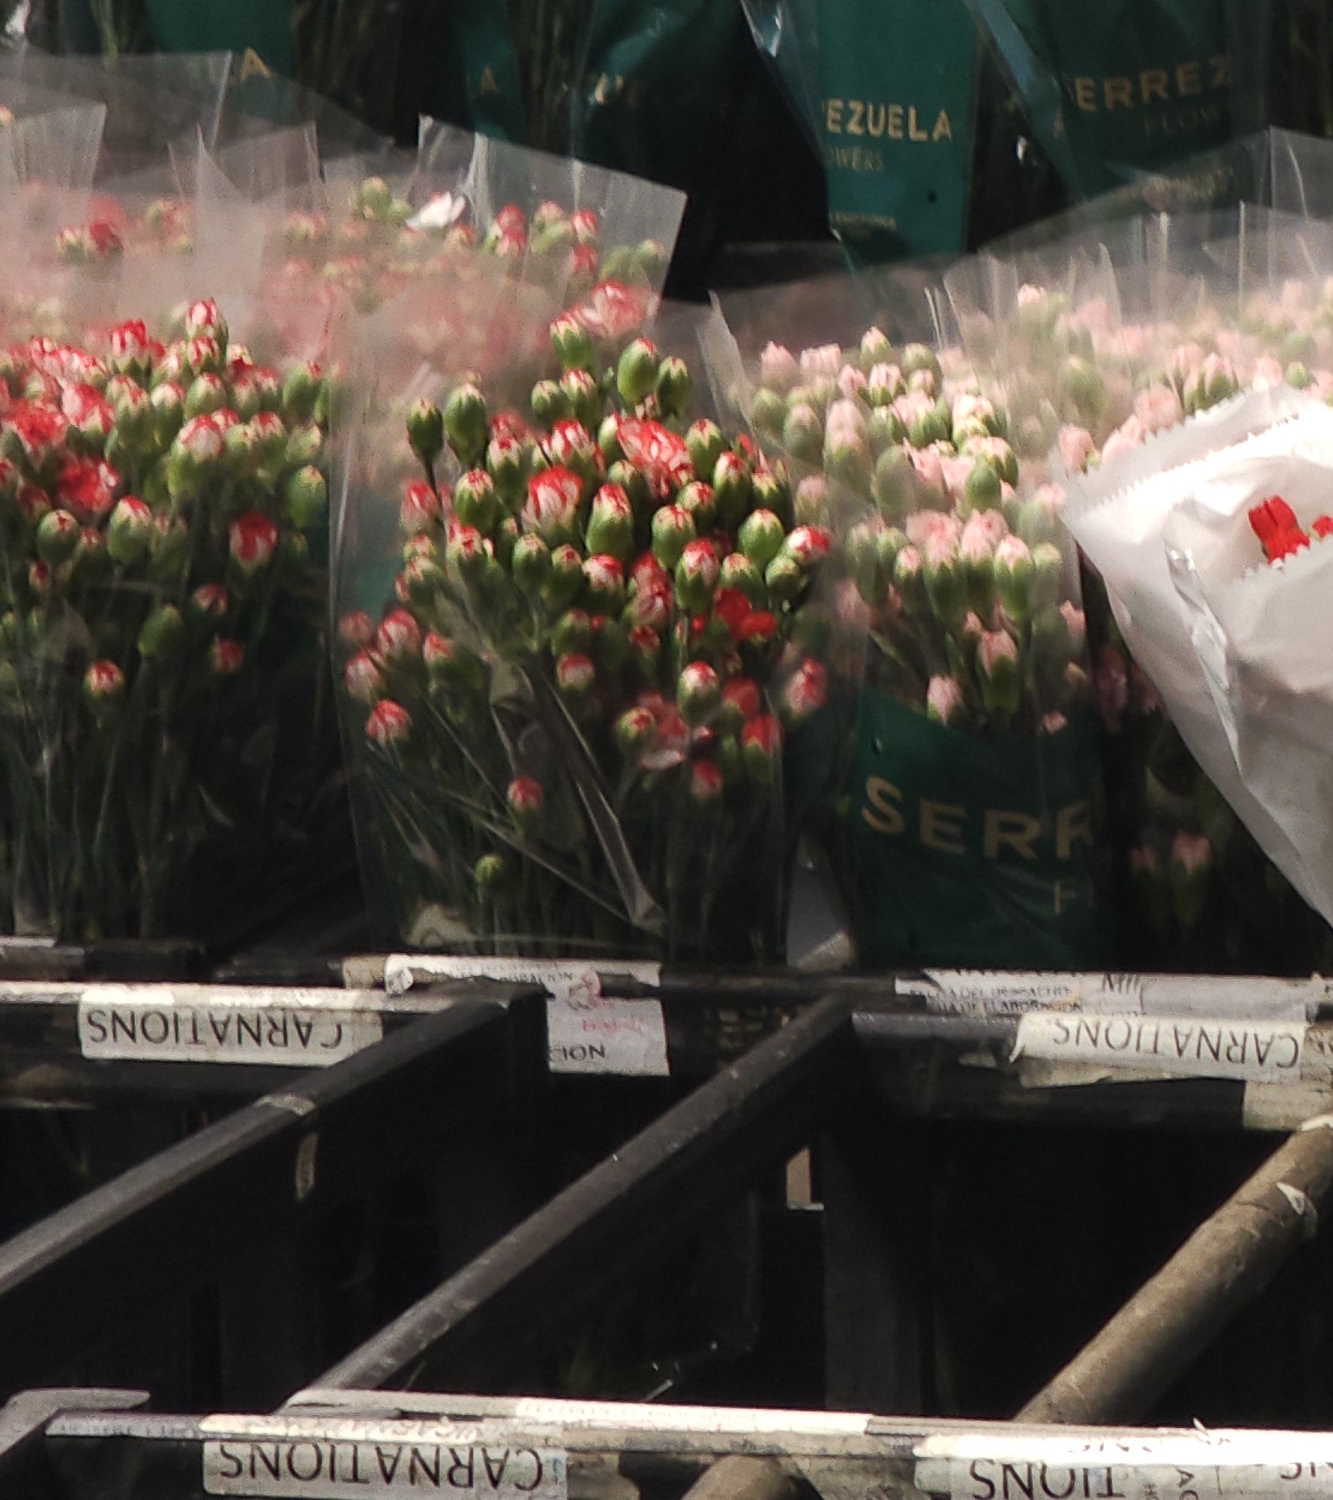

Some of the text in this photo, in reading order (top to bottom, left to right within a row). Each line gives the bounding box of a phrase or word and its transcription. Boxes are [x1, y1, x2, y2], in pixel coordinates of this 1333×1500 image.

[825, 96, 953, 143] EZUELA
[87, 1010, 343, 1049] CARNATIONS
[1045, 1018, 1300, 1069] CARNATIONS
[219, 1443, 545, 1492] CARNATIONS
